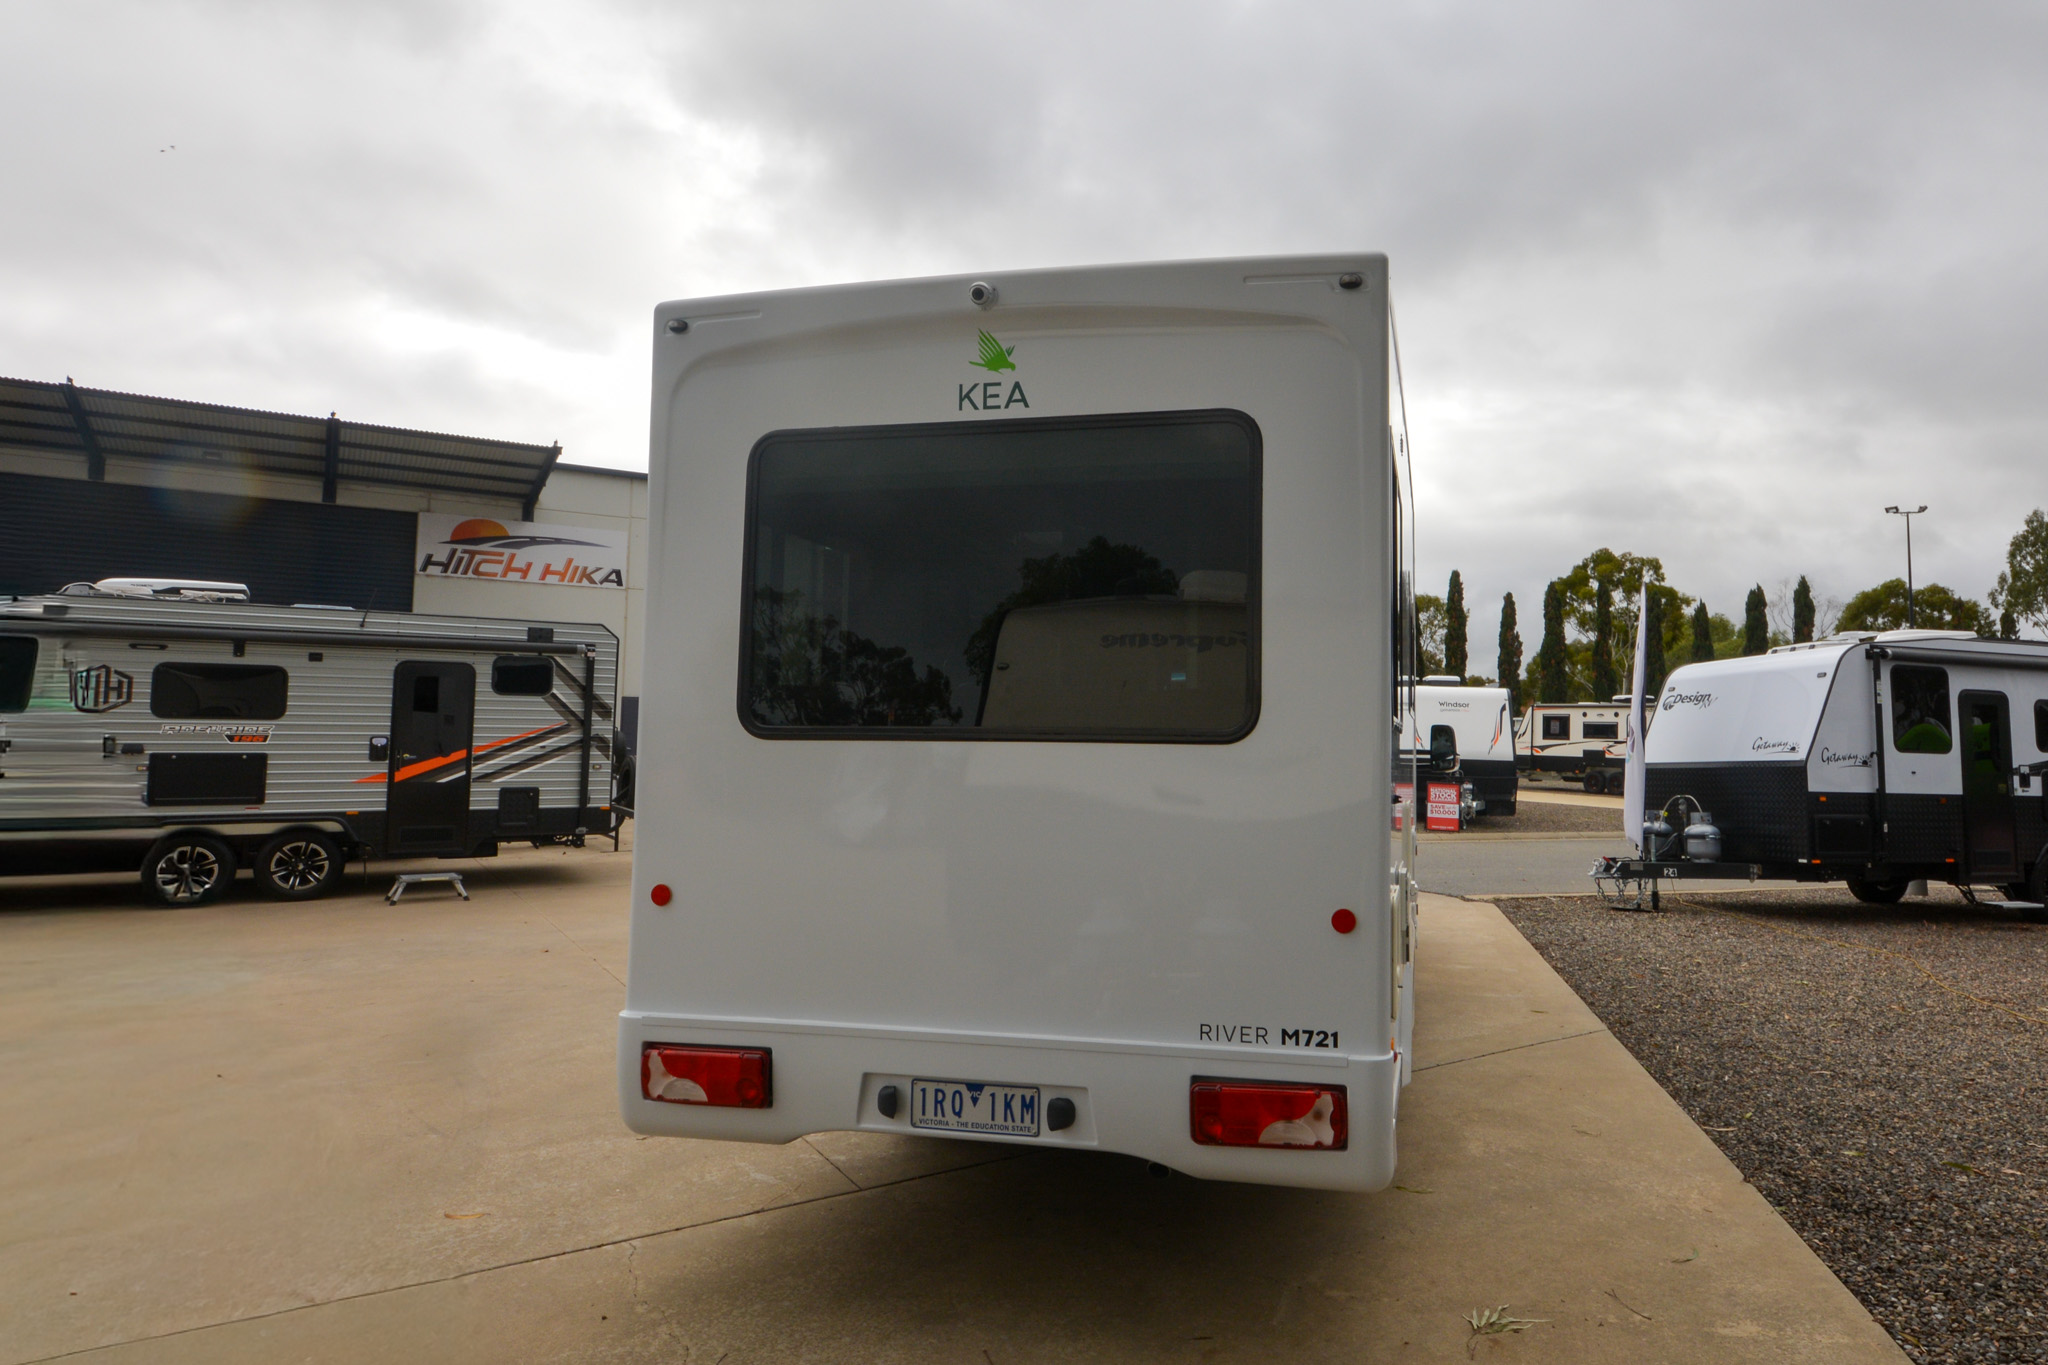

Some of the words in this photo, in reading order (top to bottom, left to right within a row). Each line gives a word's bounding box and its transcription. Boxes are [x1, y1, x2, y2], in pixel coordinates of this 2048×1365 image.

[958, 381, 1030, 411] KEA
[419, 547, 533, 580] HITCH
[538, 557, 624, 587] HIKA
[1673, 691, 1711, 706] Design
[1752, 736, 1789, 752] Getaway
[1821, 747, 1858, 765] Getaway
[1664, 868, 1677, 876] 24
[1200, 1023, 1269, 1045] RIVER
[1281, 1028, 1339, 1049] M721
[920, 1087, 964, 1118] 1RQ
[989, 1092, 1036, 1125] 1KM
[918, 1118, 950, 1127] VICTORIA
[956, 1121, 969, 1129] THE
[971, 1122, 1010, 1132] EDUCATION
